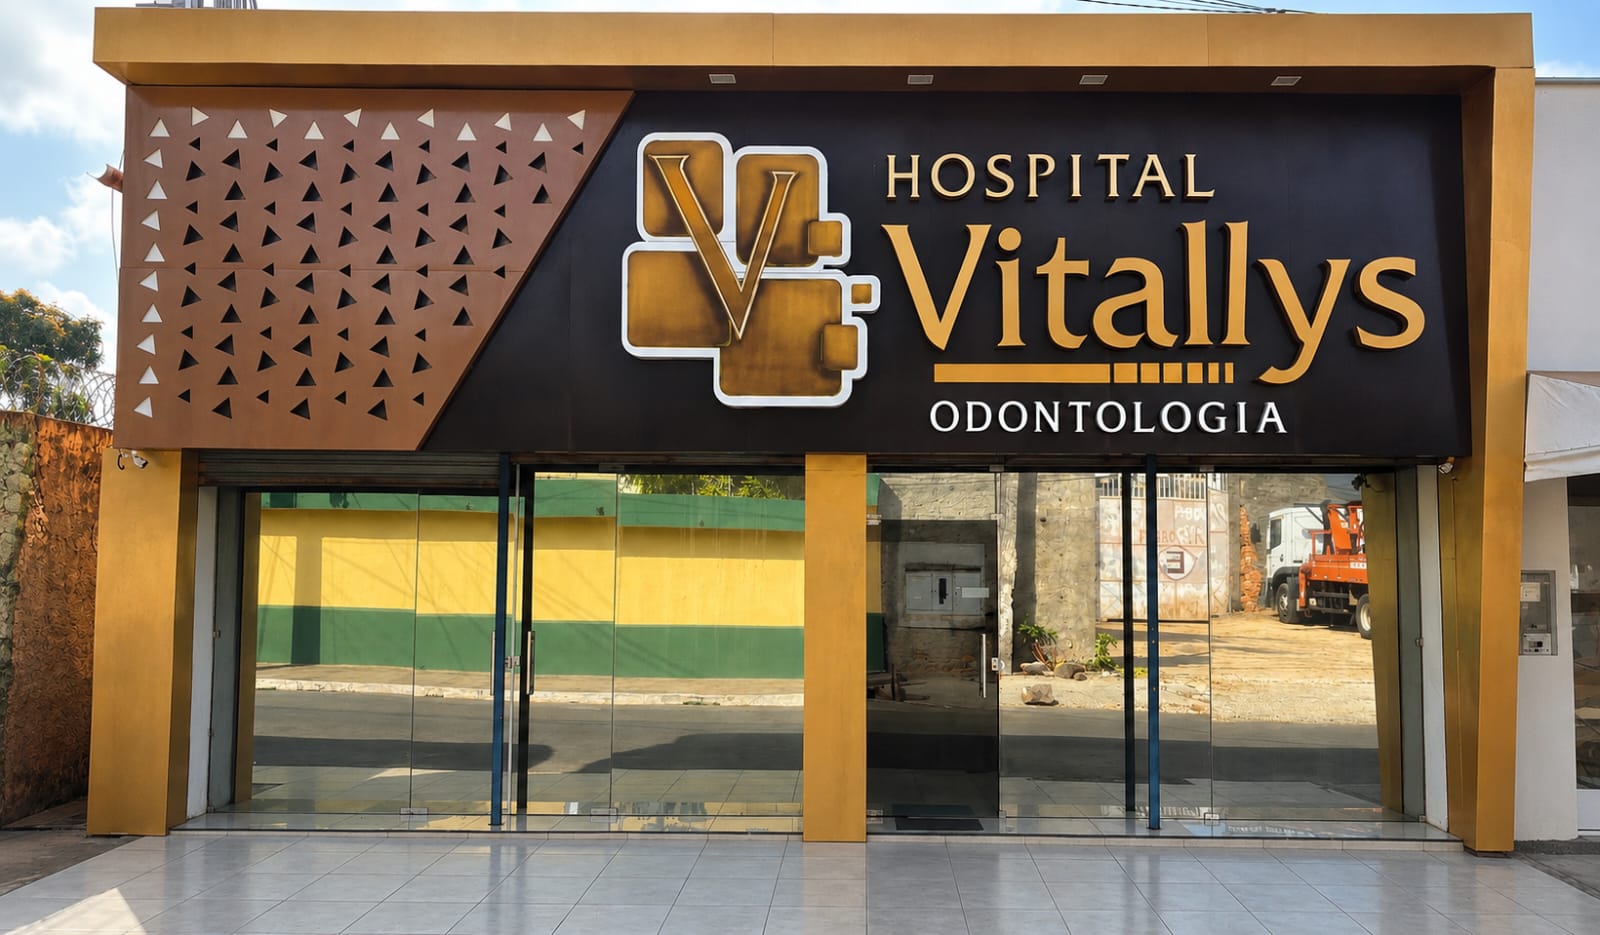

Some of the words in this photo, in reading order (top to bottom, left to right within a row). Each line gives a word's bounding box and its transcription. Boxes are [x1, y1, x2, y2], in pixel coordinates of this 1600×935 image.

[886, 153, 1216, 198] HOSPITAL
[648, 154, 798, 341] V
[881, 220, 1426, 384] Vitallys
[929, 400, 1289, 434] ODONTOLOGIA
